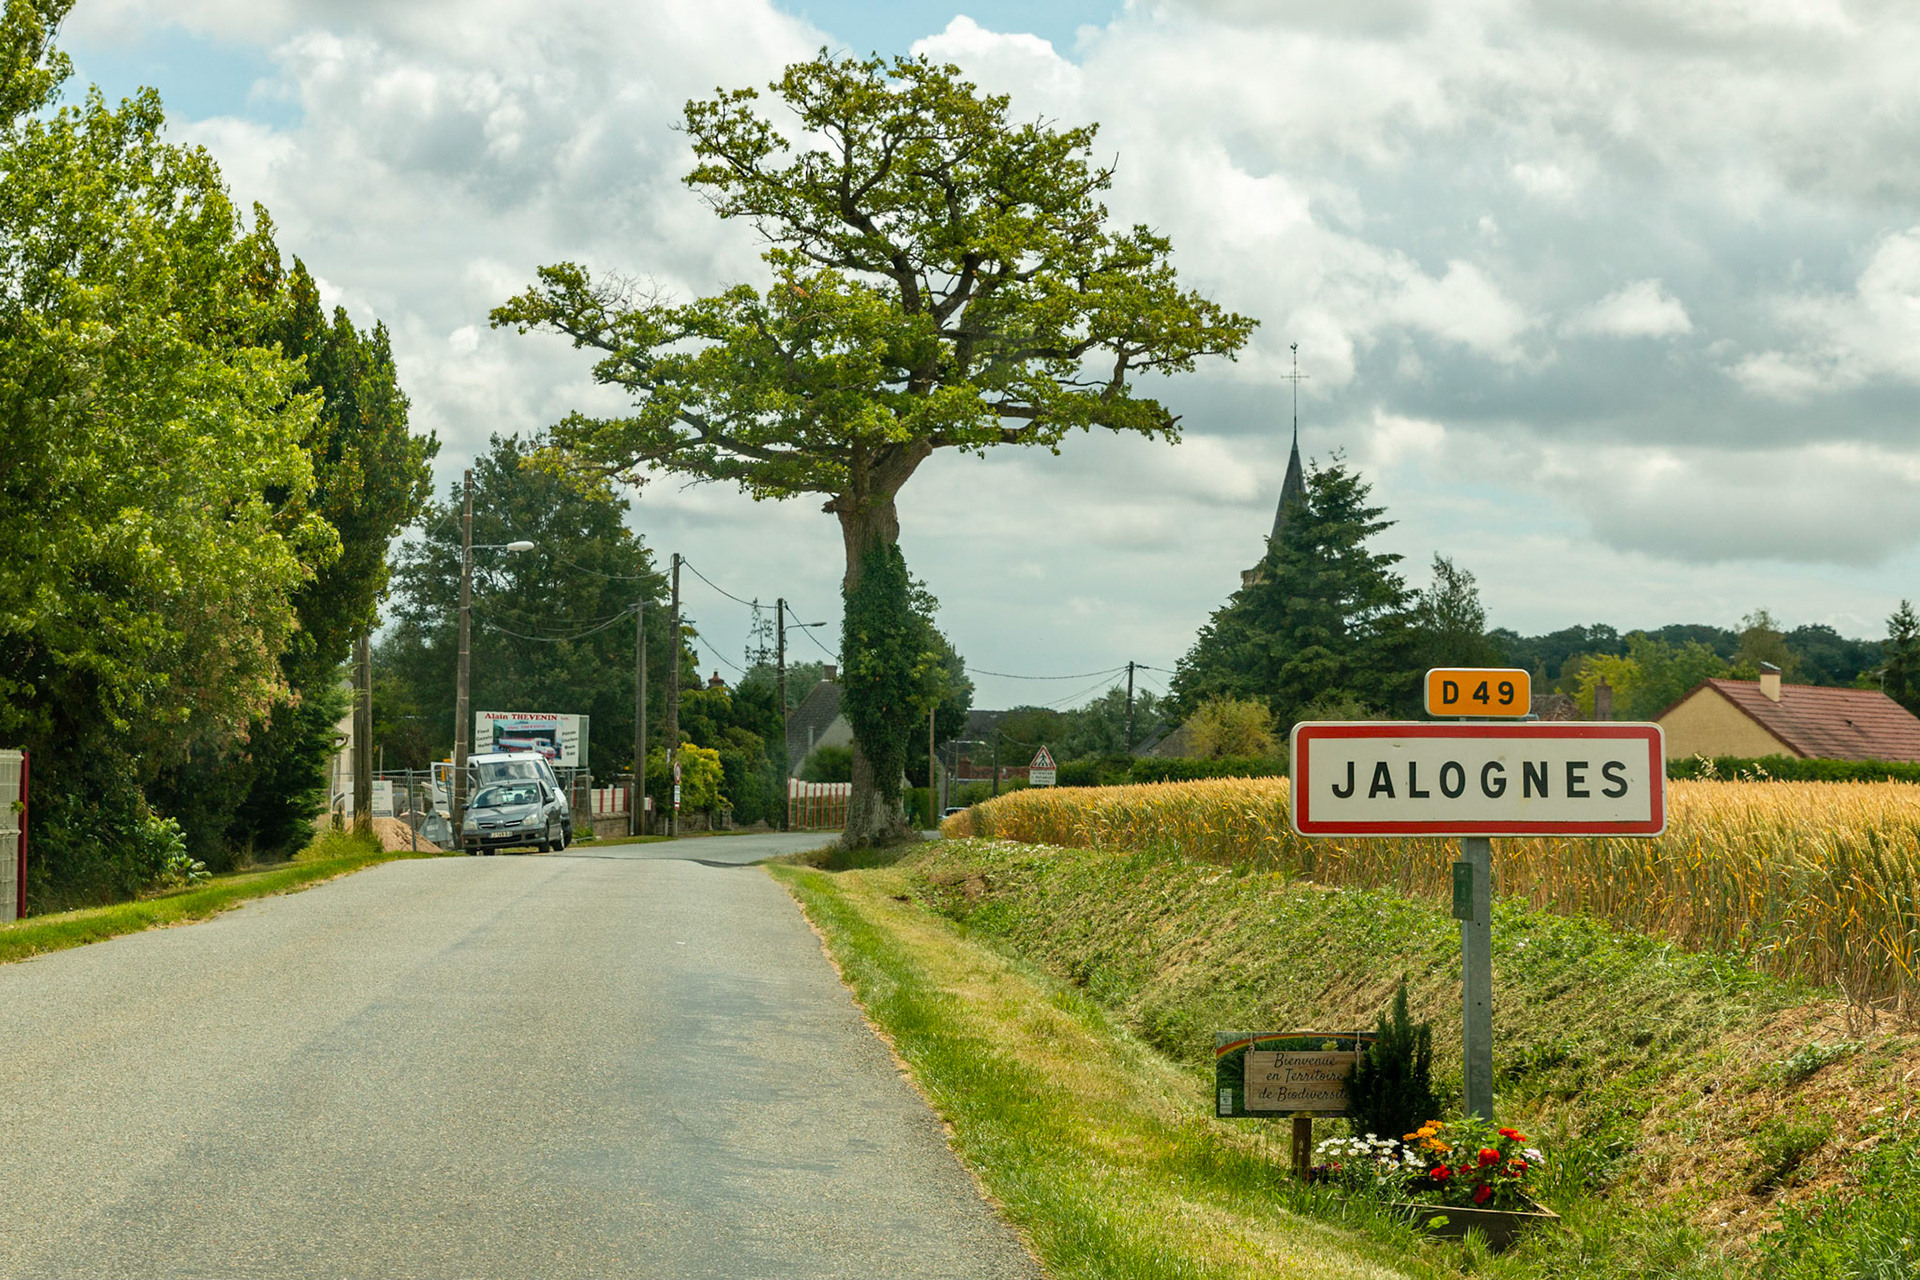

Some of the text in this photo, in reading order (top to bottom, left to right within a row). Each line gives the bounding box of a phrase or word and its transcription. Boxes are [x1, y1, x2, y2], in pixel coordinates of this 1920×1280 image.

[1442, 680, 1515, 705] D 49
[484, 712, 509, 720] Alain
[511, 713, 558, 721] THEVENIN
[1331, 760, 1628, 799] JALOGNES
[1274, 1052, 1336, 1068] Bienvenue
[1266, 1068, 1344, 1083] en Territoire
[1258, 1087, 1275, 1099] de
